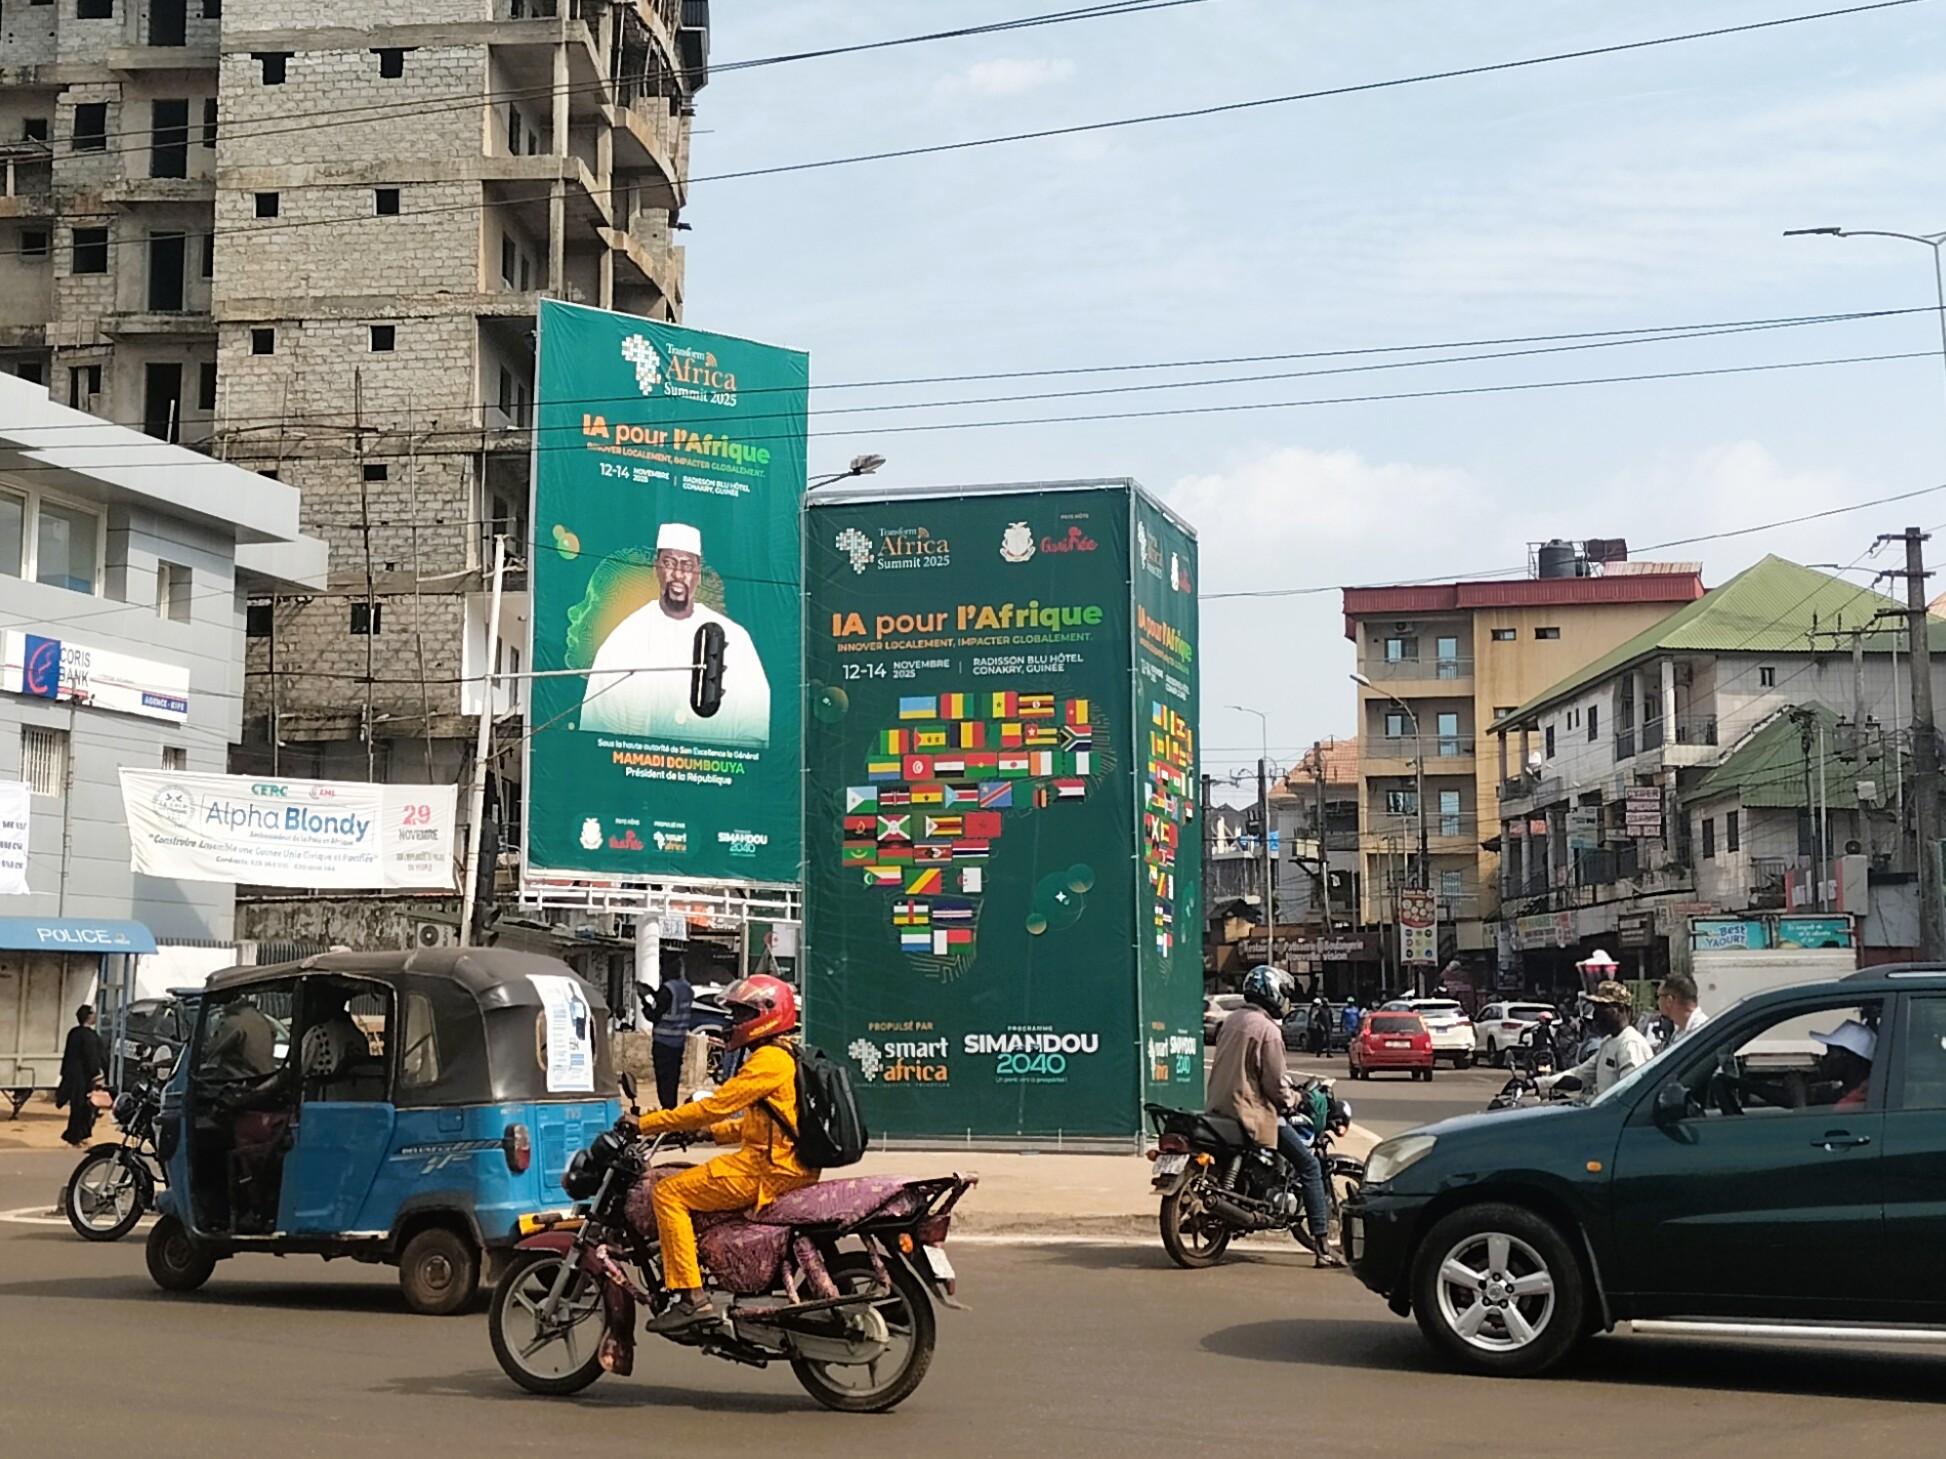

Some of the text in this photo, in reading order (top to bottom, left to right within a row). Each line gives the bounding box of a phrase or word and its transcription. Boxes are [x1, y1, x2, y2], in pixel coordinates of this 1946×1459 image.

[665, 355, 737, 391] Africa
[664, 381, 737, 407] Summit 2025
[582, 414, 771, 465] IA pour l'Afrique
[599, 462, 630, 479] 12-14
[878, 527, 917, 537] Transform
[877, 535, 950, 557] Africa
[877, 555, 950, 571] Summit 2025
[832, 612, 866, 638] IA
[876, 612, 949, 640] pour
[837, 632, 1094, 653] INNOVER LOCALEMENT, IMPACTER GLOBALEMENT.
[60, 648, 91, 668] CORIS
[892, 659, 951, 670] NOVEMBRE
[972, 652, 1084, 667] RADISSON BLU HÔTEL
[58, 666, 89, 688] BANK
[842, 663, 887, 680] 12-14
[892, 669, 916, 679] 2025
[972, 662, 1065, 676] CONAKRY, GUINÉE
[612, 751, 746, 775] MAMADI DOUMBOUYA
[625, 767, 733, 787] Président de la République
[205, 802, 370, 842] Alpha Blondy
[402, 804, 431, 825] 29
[37, 927, 112, 944] POLICE
[1719, 924, 1746, 937] Best
[1705, 935, 1746, 948] YAOURT
[868, 1021, 934, 1031] PROPULSÉ PAR
[884, 1036, 949, 1058] smart
[963, 1032, 1099, 1054] SIMANDOU
[883, 1057, 948, 1082] africa
[996, 1053, 1066, 1074] 2040
